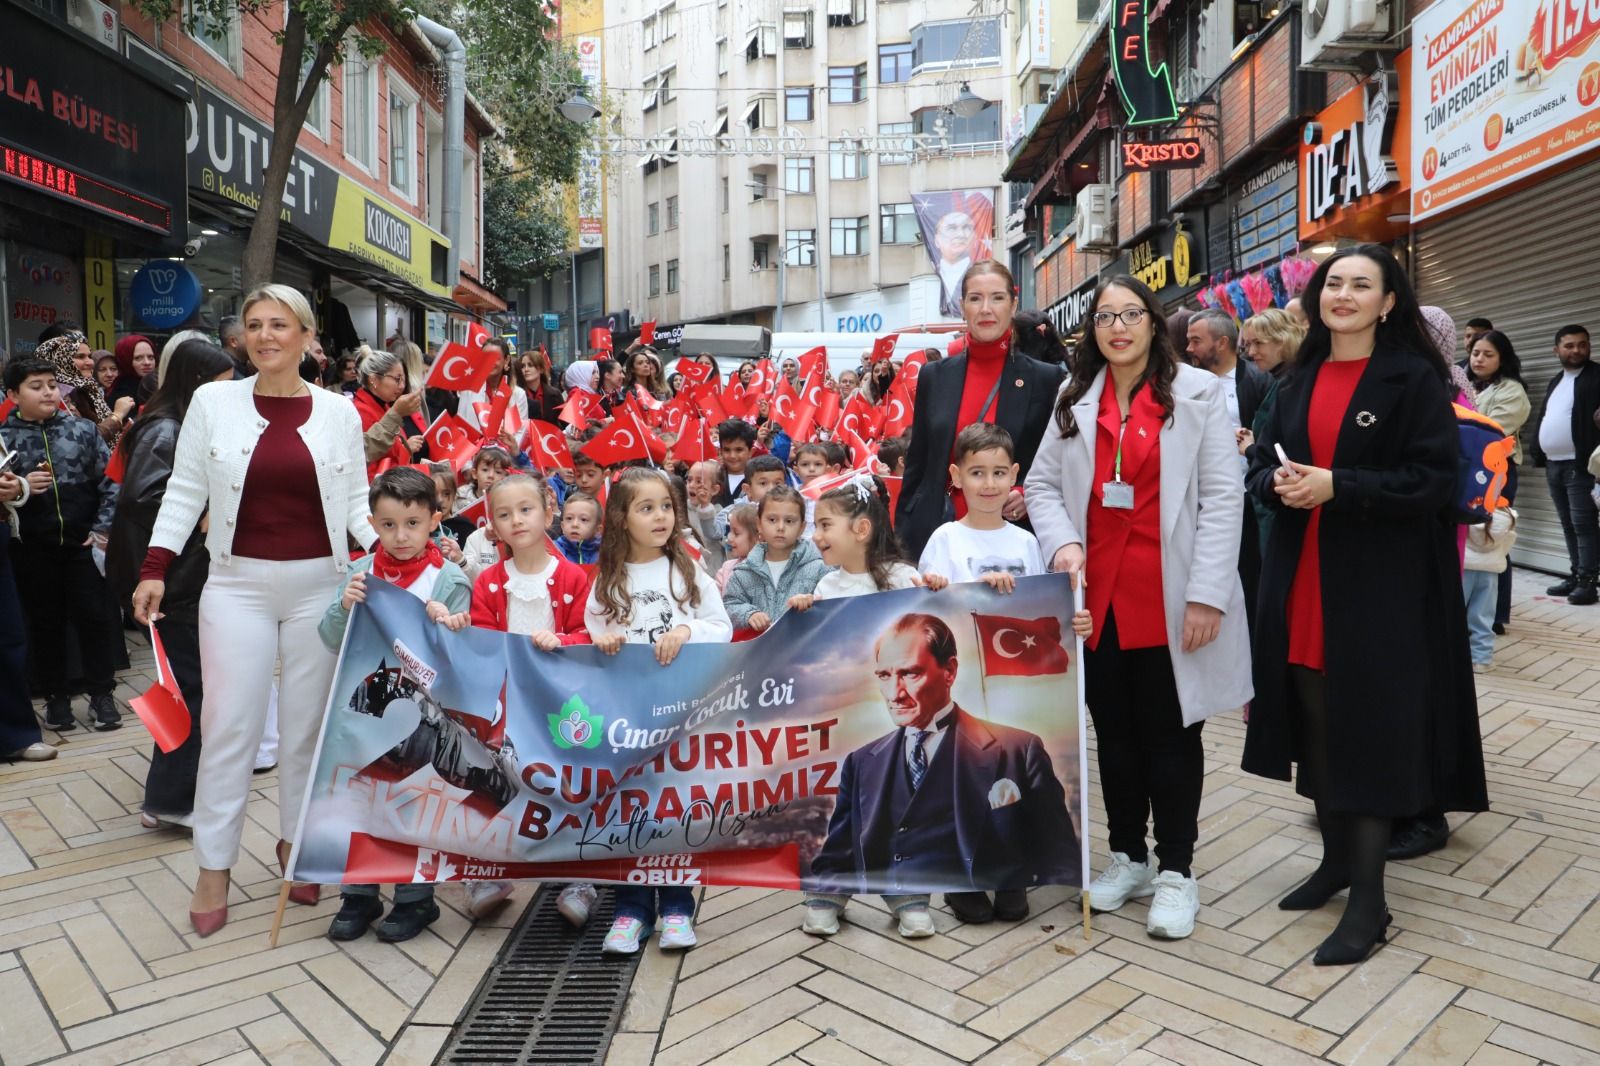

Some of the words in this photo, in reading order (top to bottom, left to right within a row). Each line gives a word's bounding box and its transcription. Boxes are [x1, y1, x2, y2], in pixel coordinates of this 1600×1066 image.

[1431, 24, 1498, 104] EVİNİZİN
[0, 65, 45, 112] LA
[52, 89, 138, 152] BÜFESİ
[1425, 101, 1446, 134] TÜM
[1448, 50, 1509, 119] PERDELERİ
[1505, 117, 1514, 134] 4
[1515, 112, 1532, 126] ADET
[5, 148, 77, 196] NUMARA
[1123, 142, 1200, 168] KRISTO
[1440, 152, 1447, 167] 4
[1447, 149, 1460, 160] ADET
[367, 205, 410, 259] KOKOSH
[142, 305, 184, 317] piyango
[152, 297, 173, 305] milli
[837, 313, 882, 333] FOKO
[608, 718, 680, 754] Çınar
[758, 678, 795, 707] Evi
[652, 700, 686, 717] İzmit
[521, 719, 838, 804] CUMHURİYET
[517, 761, 840, 841] BAYRAMIMIZ
[575, 807, 672, 860] Kutlu
[682, 799, 792, 849] Olsun
[463, 861, 506, 877] İZMİT
